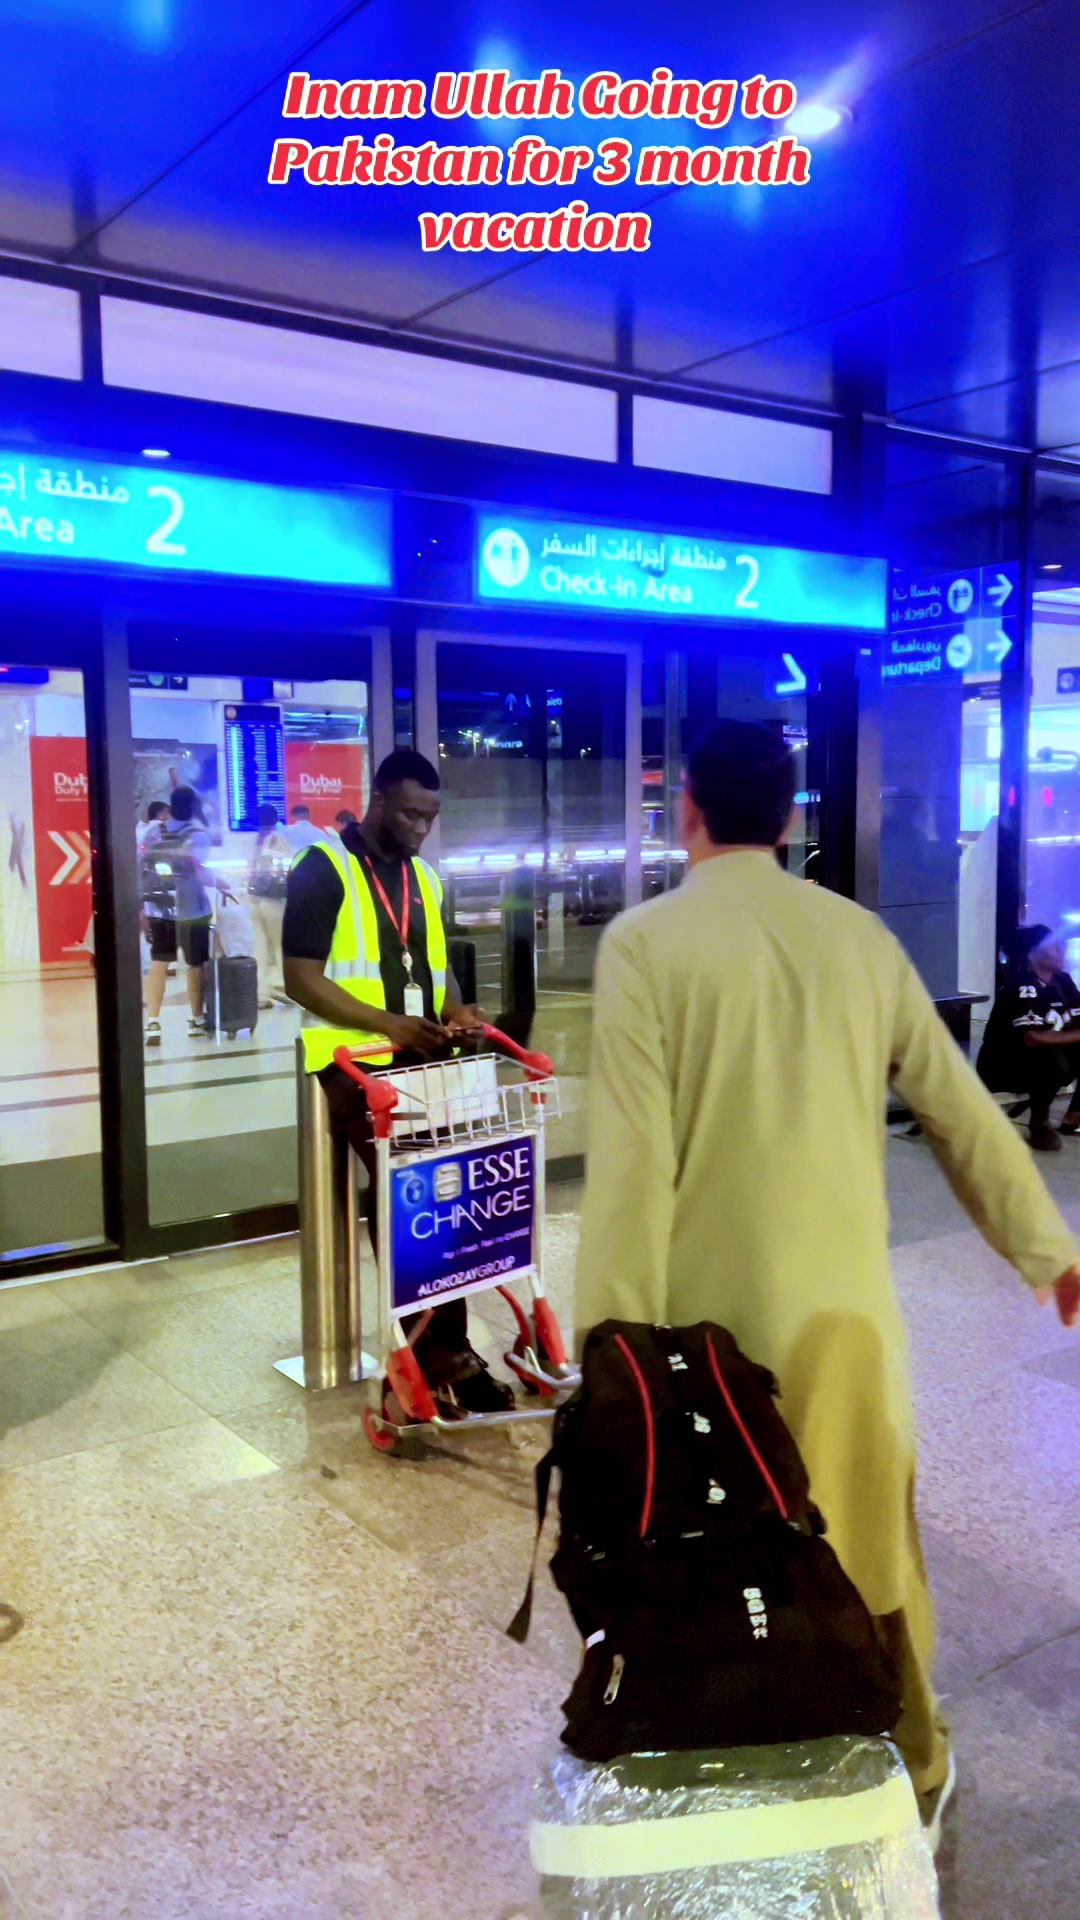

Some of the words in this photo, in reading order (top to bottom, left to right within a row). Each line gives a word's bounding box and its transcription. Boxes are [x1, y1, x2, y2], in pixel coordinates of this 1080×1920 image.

[35, 467, 130, 503] منطقة
[145, 485, 188, 555] 2
[540, 532, 597, 559] السفر
[601, 540, 666, 572] إجراءات
[670, 546, 727, 571] منطقة
[539, 564, 637, 598] Check-In
[643, 576, 694, 604] Area
[734, 554, 760, 609] 2
[299, 773, 342, 787] Dubai
[1019, 985, 1037, 999] 23
[467, 1147, 531, 1191] ESSE
[411, 1184, 531, 1239] CHANGE
